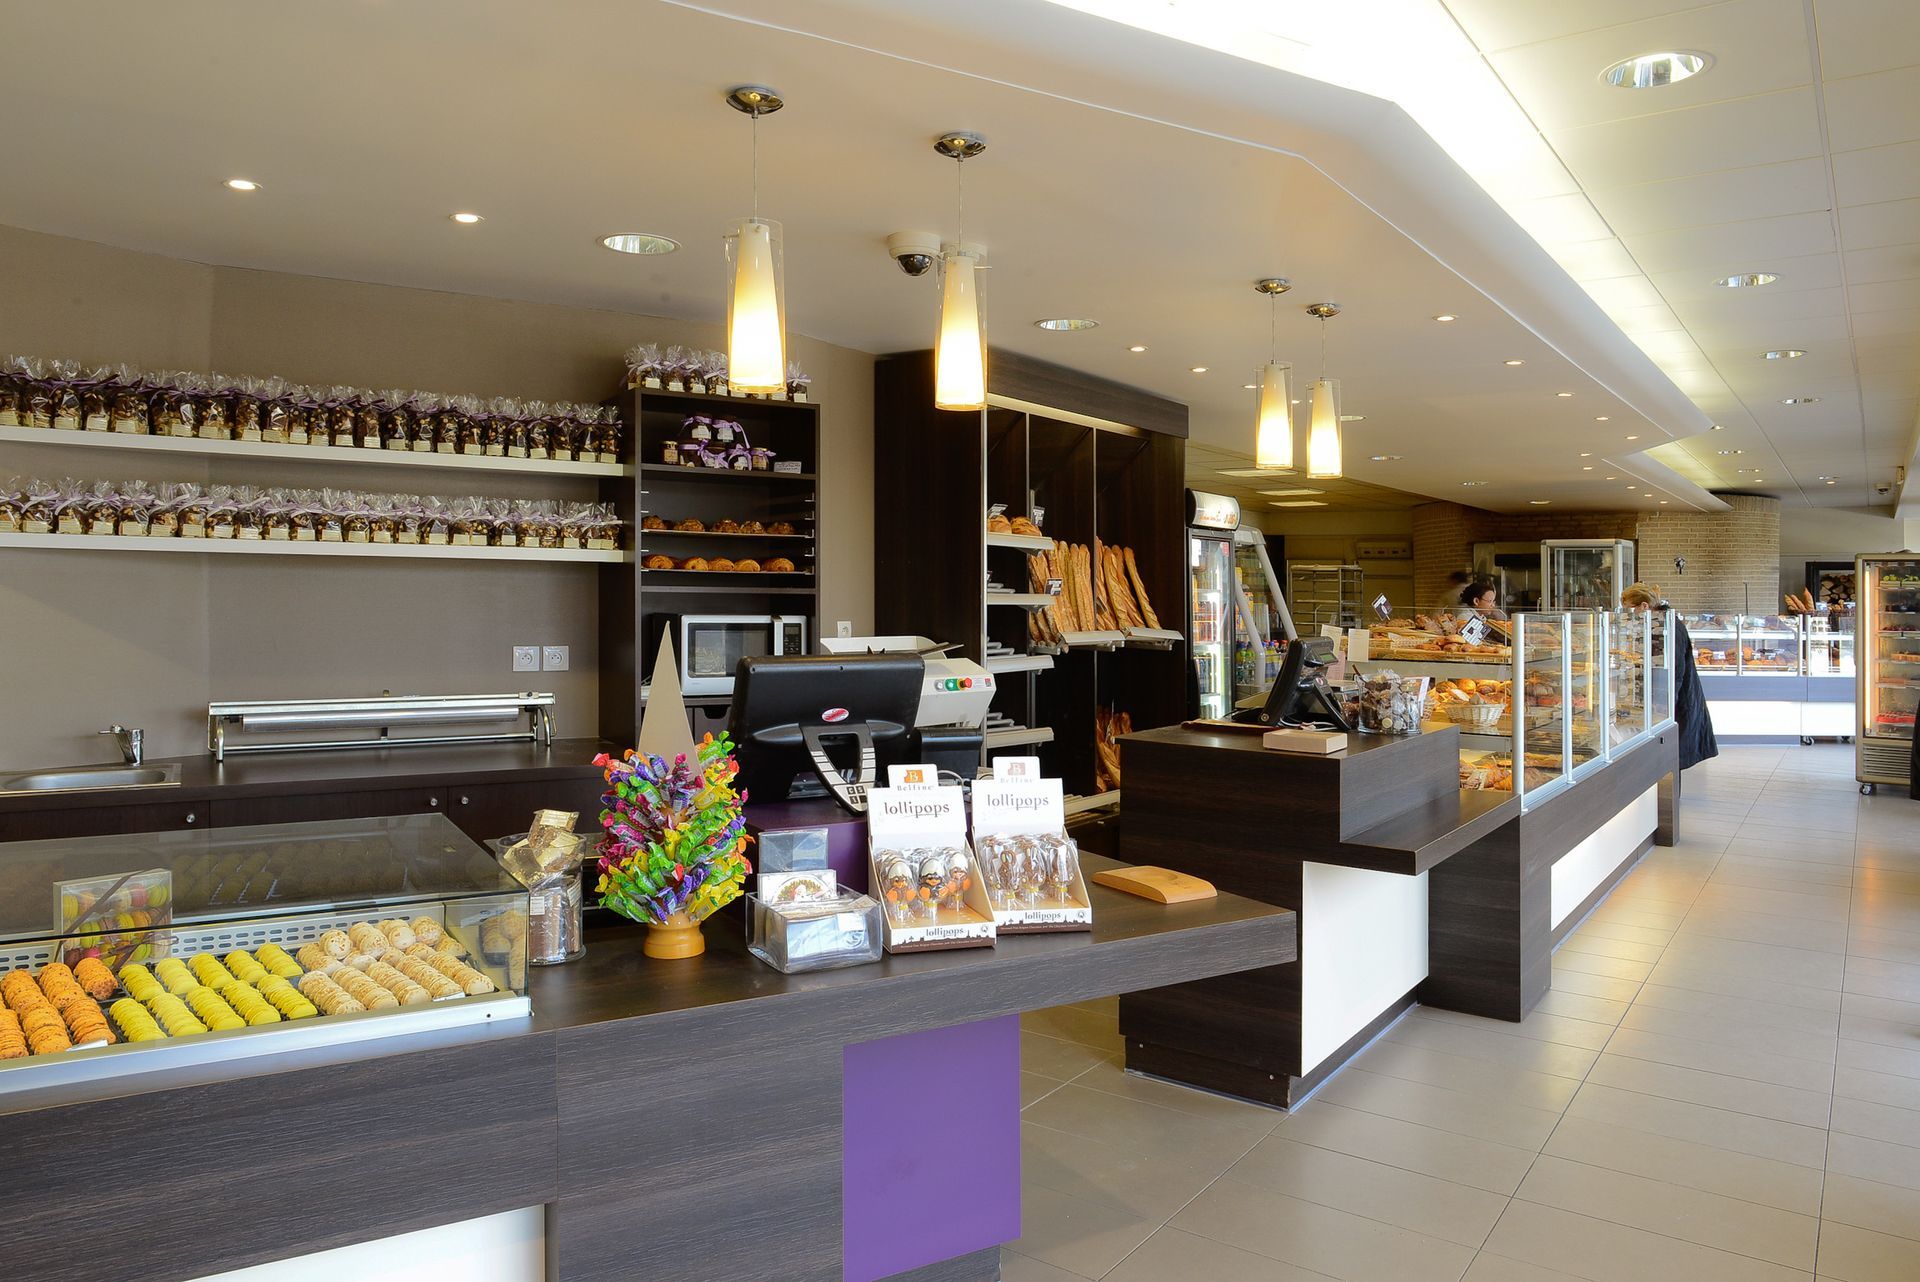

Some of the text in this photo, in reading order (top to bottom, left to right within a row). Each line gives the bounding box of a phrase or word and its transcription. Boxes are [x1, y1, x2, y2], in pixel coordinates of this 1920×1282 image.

[987, 793, 1050, 811] lollipops
[884, 801, 950, 818] lollipops
[1024, 911, 1061, 921] lollipops
[926, 927, 964, 938] lollipops
